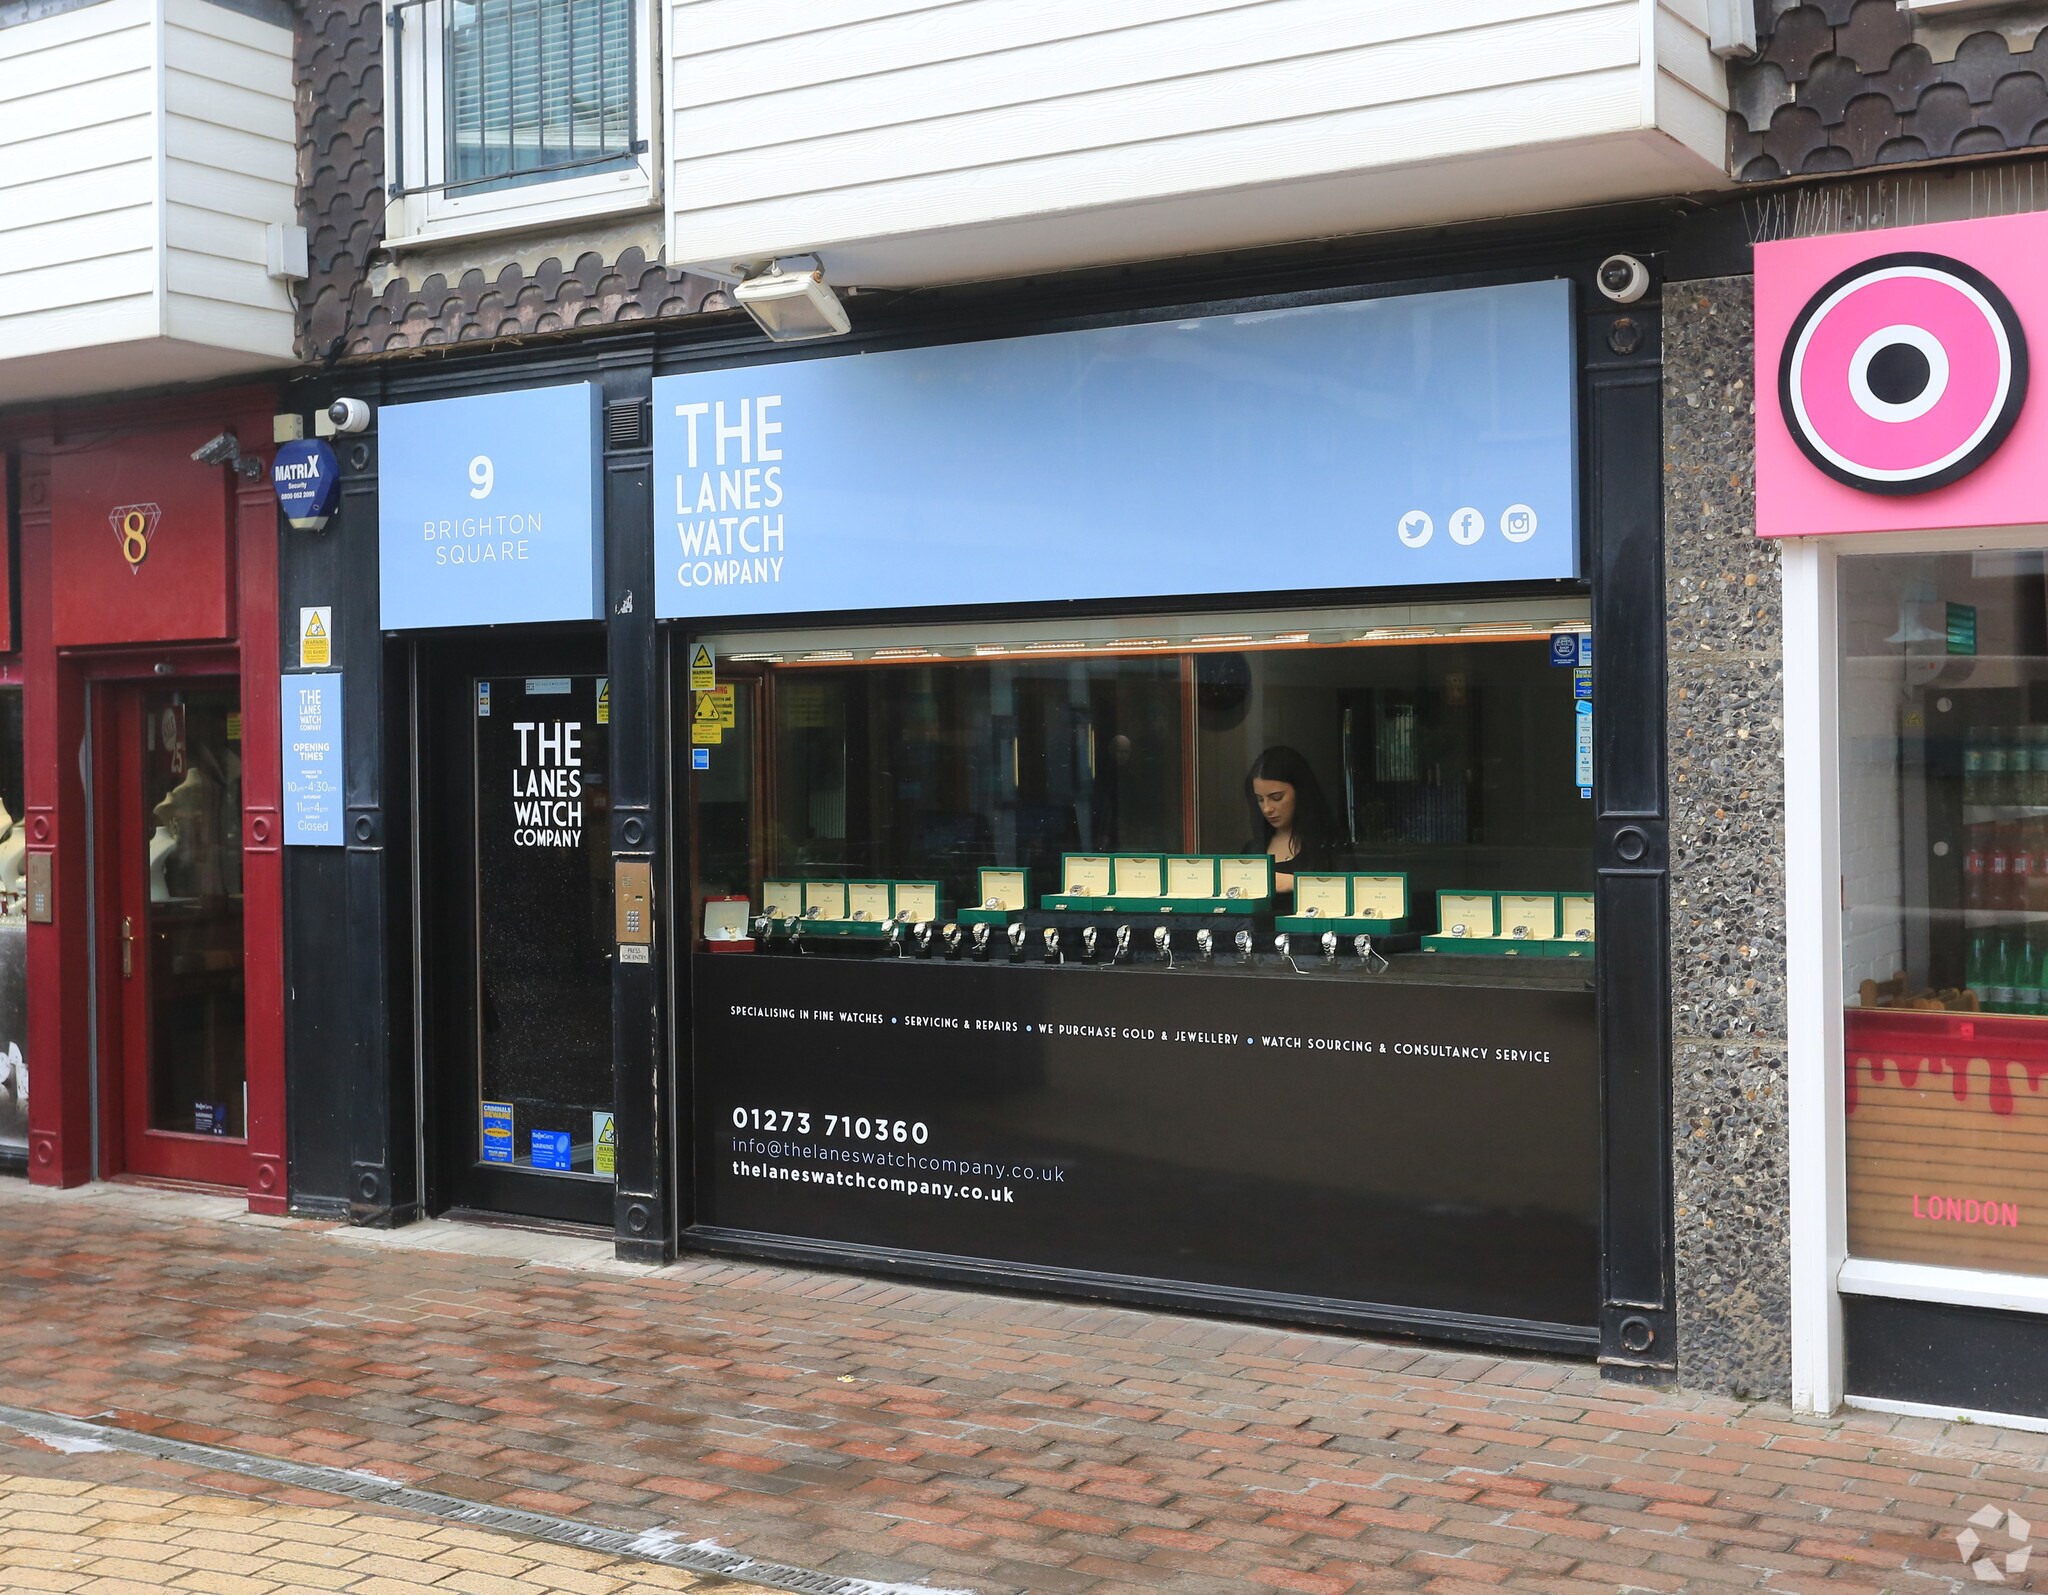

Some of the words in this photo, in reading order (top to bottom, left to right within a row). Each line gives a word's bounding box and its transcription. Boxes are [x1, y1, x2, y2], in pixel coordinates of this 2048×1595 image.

[675, 394, 783, 468] THE
[275, 454, 320, 481] MATRIX
[468, 455, 494, 500] 9
[288, 482, 307, 490] Security
[676, 466, 784, 515] LANES
[123, 511, 148, 564] 8
[424, 513, 541, 541] BRIGHTON
[676, 513, 784, 557] WATCH
[436, 540, 529, 565] SQUARE
[677, 556, 784, 587] COMPANY
[299, 689, 321, 705] THE
[300, 705, 322, 715] LANES
[300, 715, 322, 725] WATCH
[300, 724, 322, 732] COMPANY
[293, 742, 330, 752] OPENING
[300, 752, 324, 761] TIMES
[513, 722, 582, 766] THE
[513, 769, 582, 797] LANES
[297, 820, 329, 832] Closed
[513, 801, 582, 827] WATCH
[513, 829, 582, 847] COMPANY
[730, 1005, 795, 1019] SPECIALISING
[800, 1009, 809, 1019] IN
[813, 1010, 834, 1021] FINE
[839, 1012, 883, 1024] WATCHES
[904, 1016, 958, 1029] SERVICING
[963, 1020, 970, 1029] &
[975, 1020, 1018, 1032] REPAIRS
[1038, 1023, 1054, 1034] WE
[1059, 1024, 1117, 1038] PURCHASE
[1122, 1028, 1155, 1040] GOLD
[1161, 1031, 1168, 1041] &
[1174, 1031, 1239, 1045] JEWELLERY
[1261, 1036, 1301, 1048] WATCH
[1307, 1038, 1372, 1053] SOURCING
[1379, 1043, 1387, 1053] &
[1394, 1043, 1488, 1060] CONSULTANCY
[1495, 1049, 1550, 1063] SERVICE
[732, 1107, 811, 1134] 01273
[824, 1114, 929, 1144] 710360
[732, 1137, 1065, 1182] info@thelaneswatchcompany.co.uk
[732, 1161, 1015, 1203] thelaneswatchcompany.co.uk
[1913, 1194, 2018, 1228] LONDON
